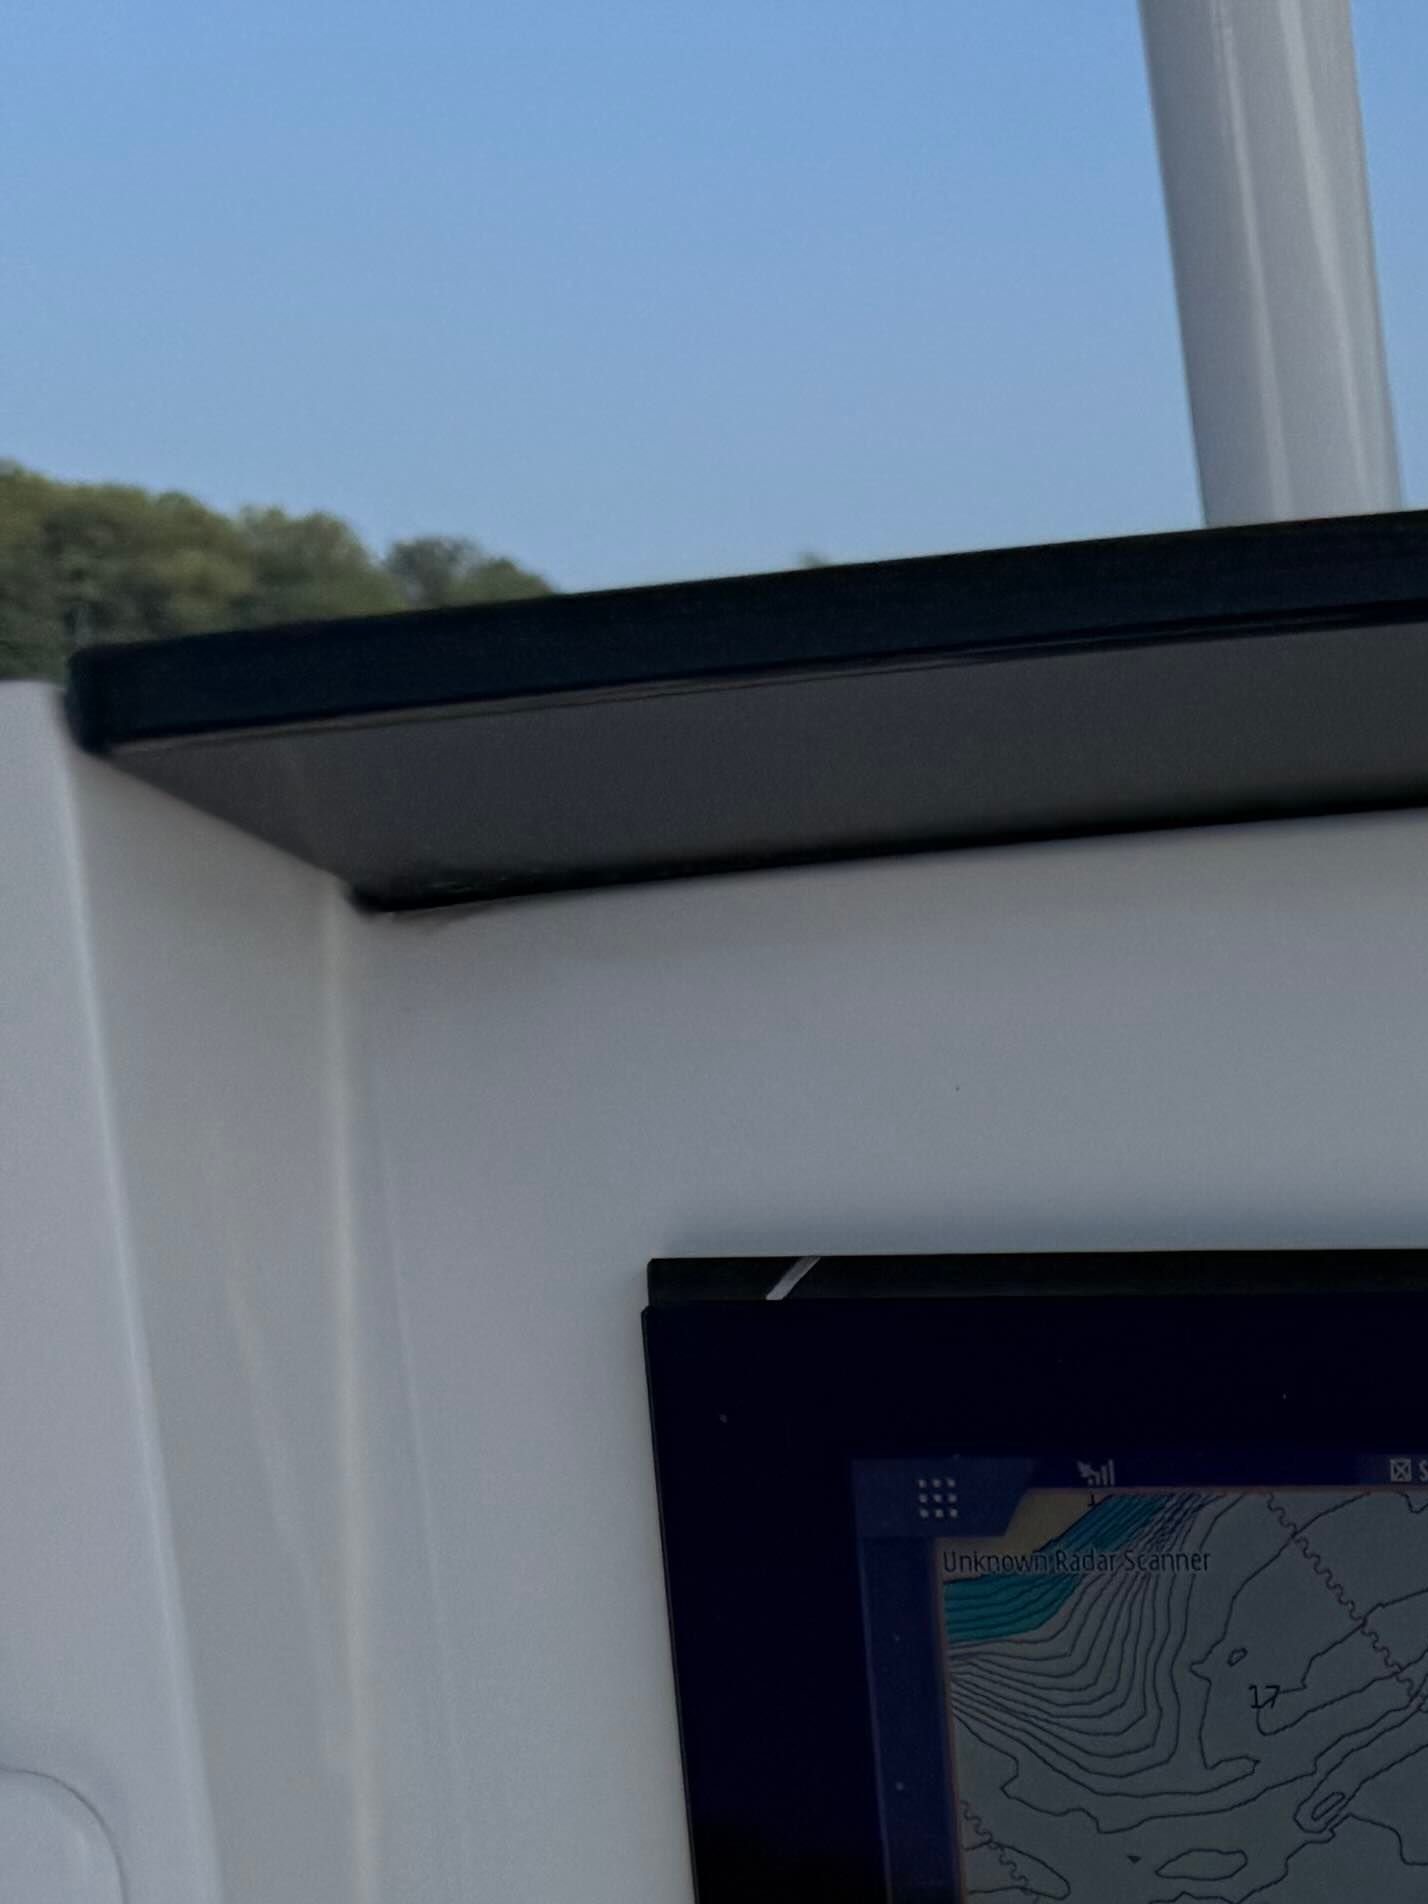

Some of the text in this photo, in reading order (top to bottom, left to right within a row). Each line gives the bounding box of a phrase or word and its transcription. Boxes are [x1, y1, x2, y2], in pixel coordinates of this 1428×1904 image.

[943, 1549, 1212, 1574] Unknown Radar Scanner
[1249, 1684, 1281, 1709] 17
